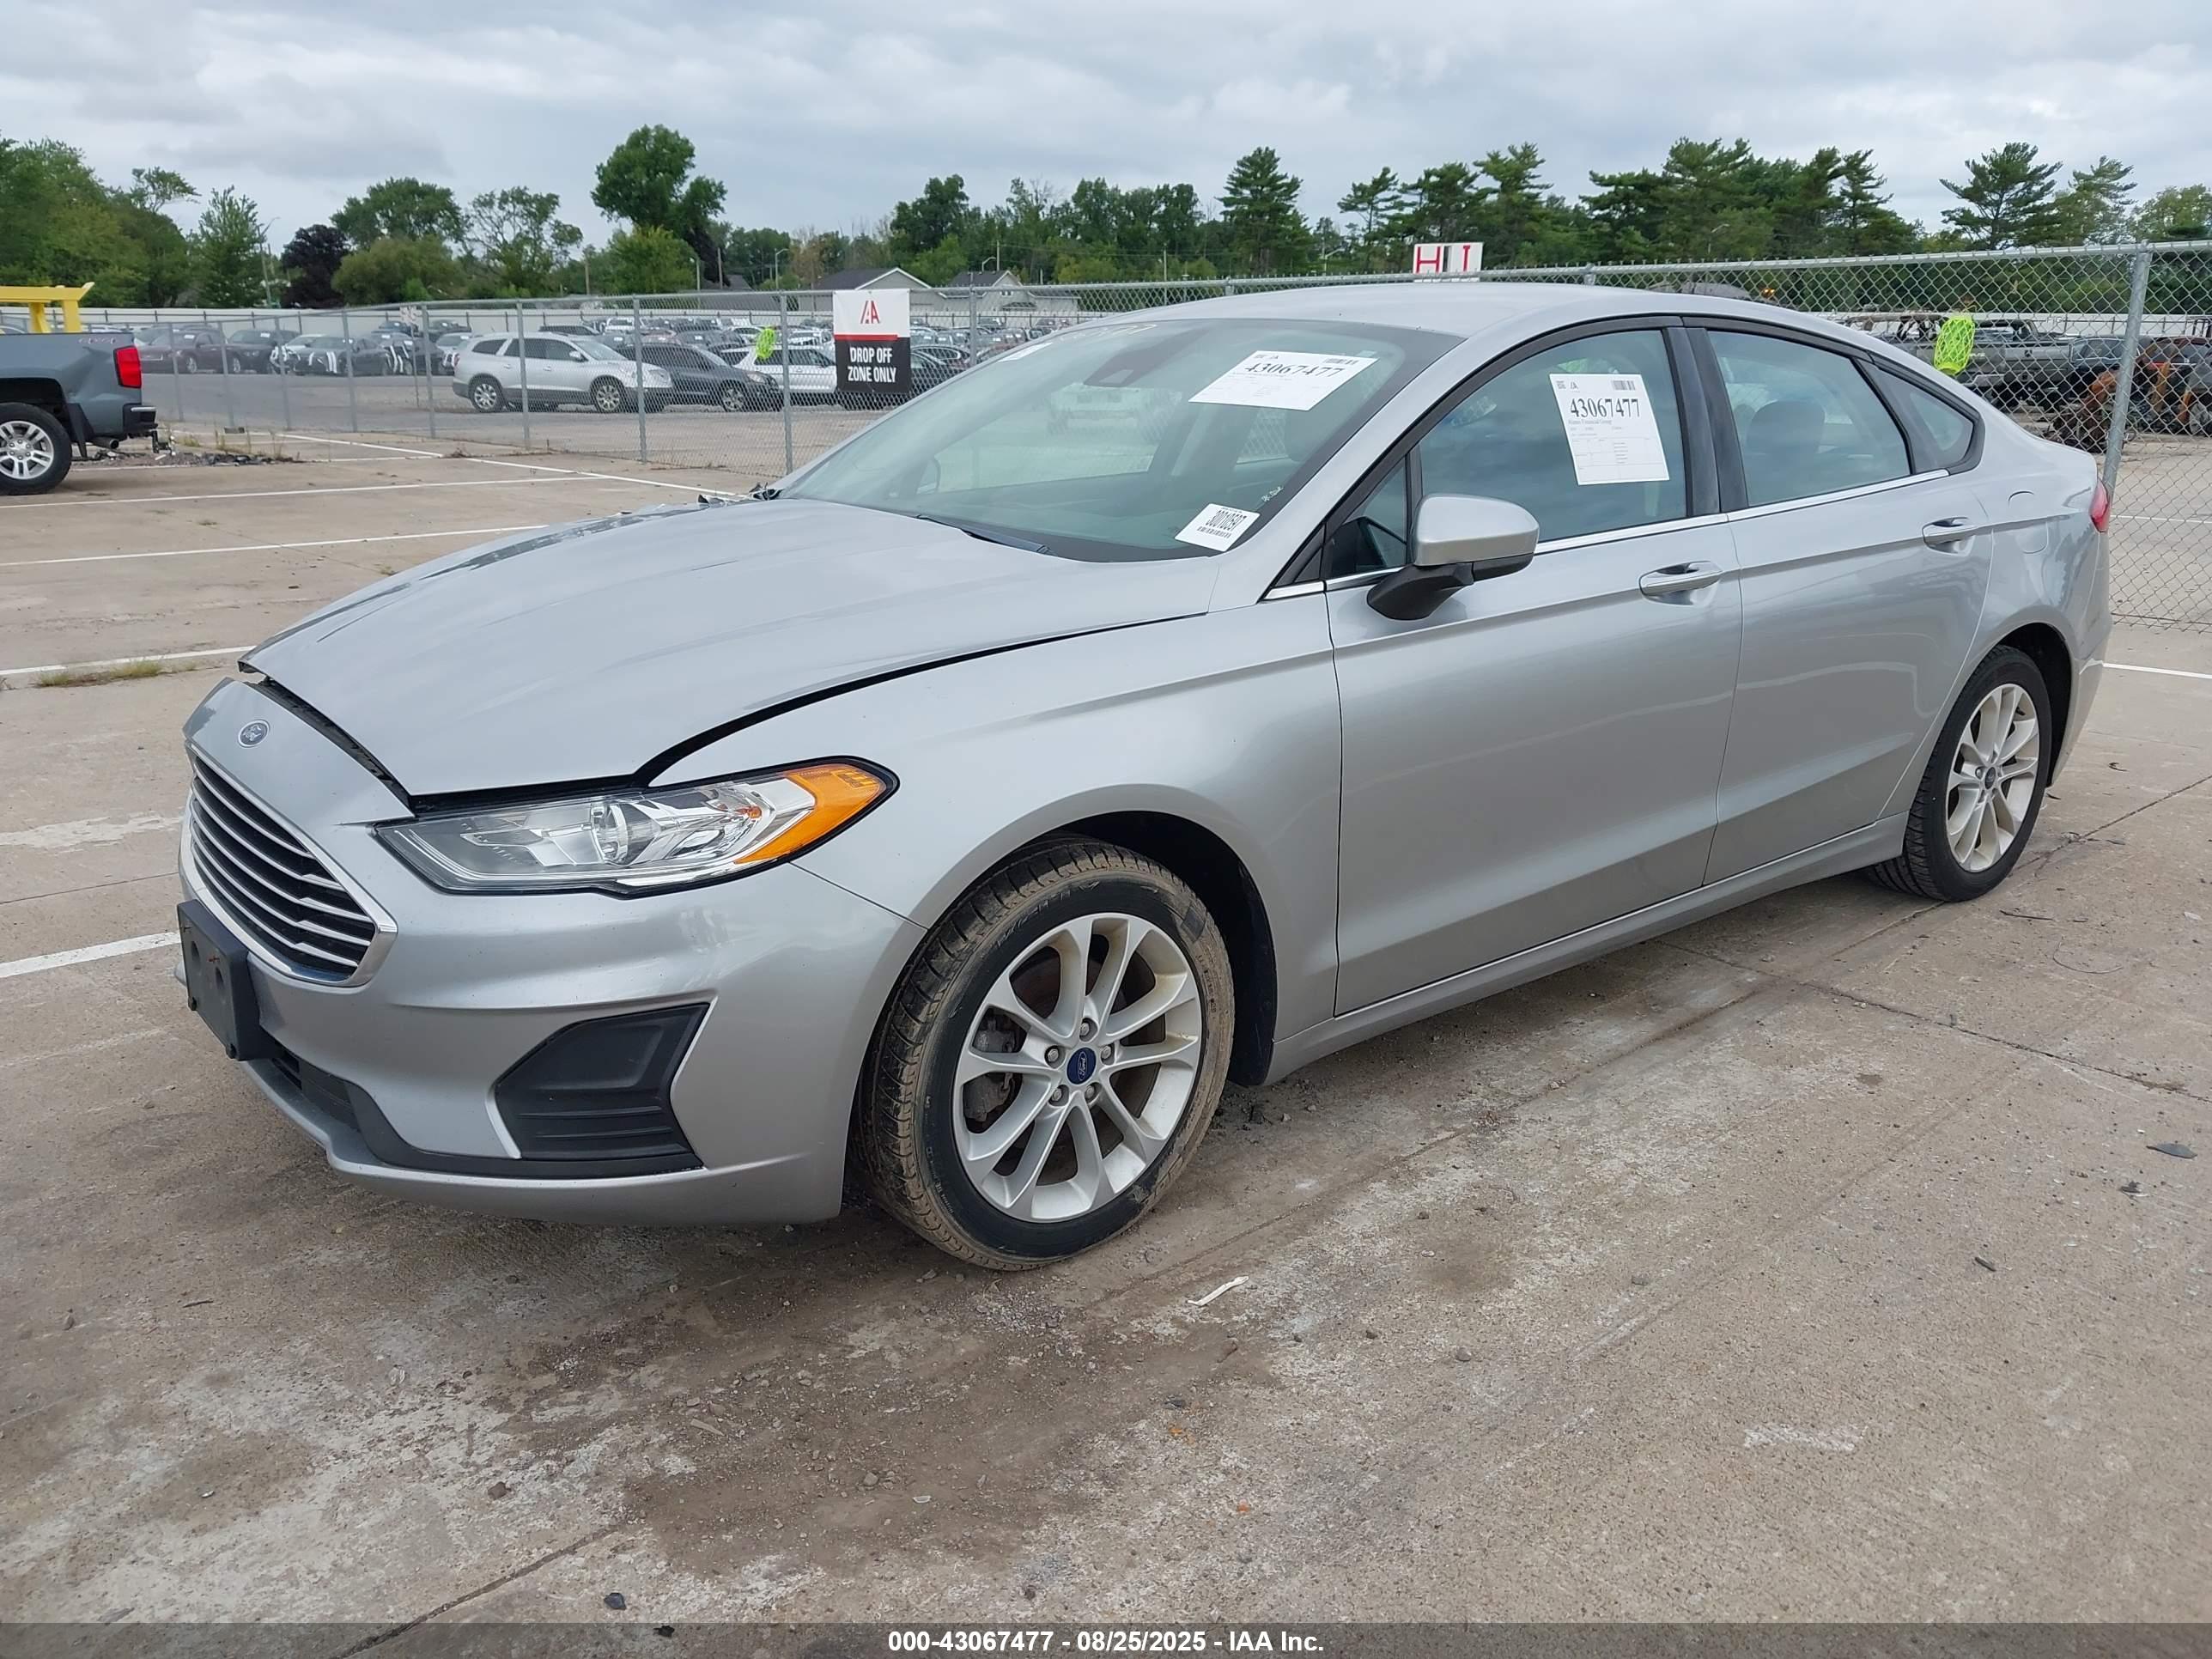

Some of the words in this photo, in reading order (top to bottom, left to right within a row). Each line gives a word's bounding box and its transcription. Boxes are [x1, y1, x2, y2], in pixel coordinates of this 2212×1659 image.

[1415, 246, 1442, 275] H
[849, 347, 873, 363] DROP
[876, 348, 892, 364] OFF
[848, 367, 872, 382] ZONE
[874, 367, 897, 383] ONLY
[1244, 362, 1345, 378] 43067477
[1570, 398, 1640, 418] 43067477
